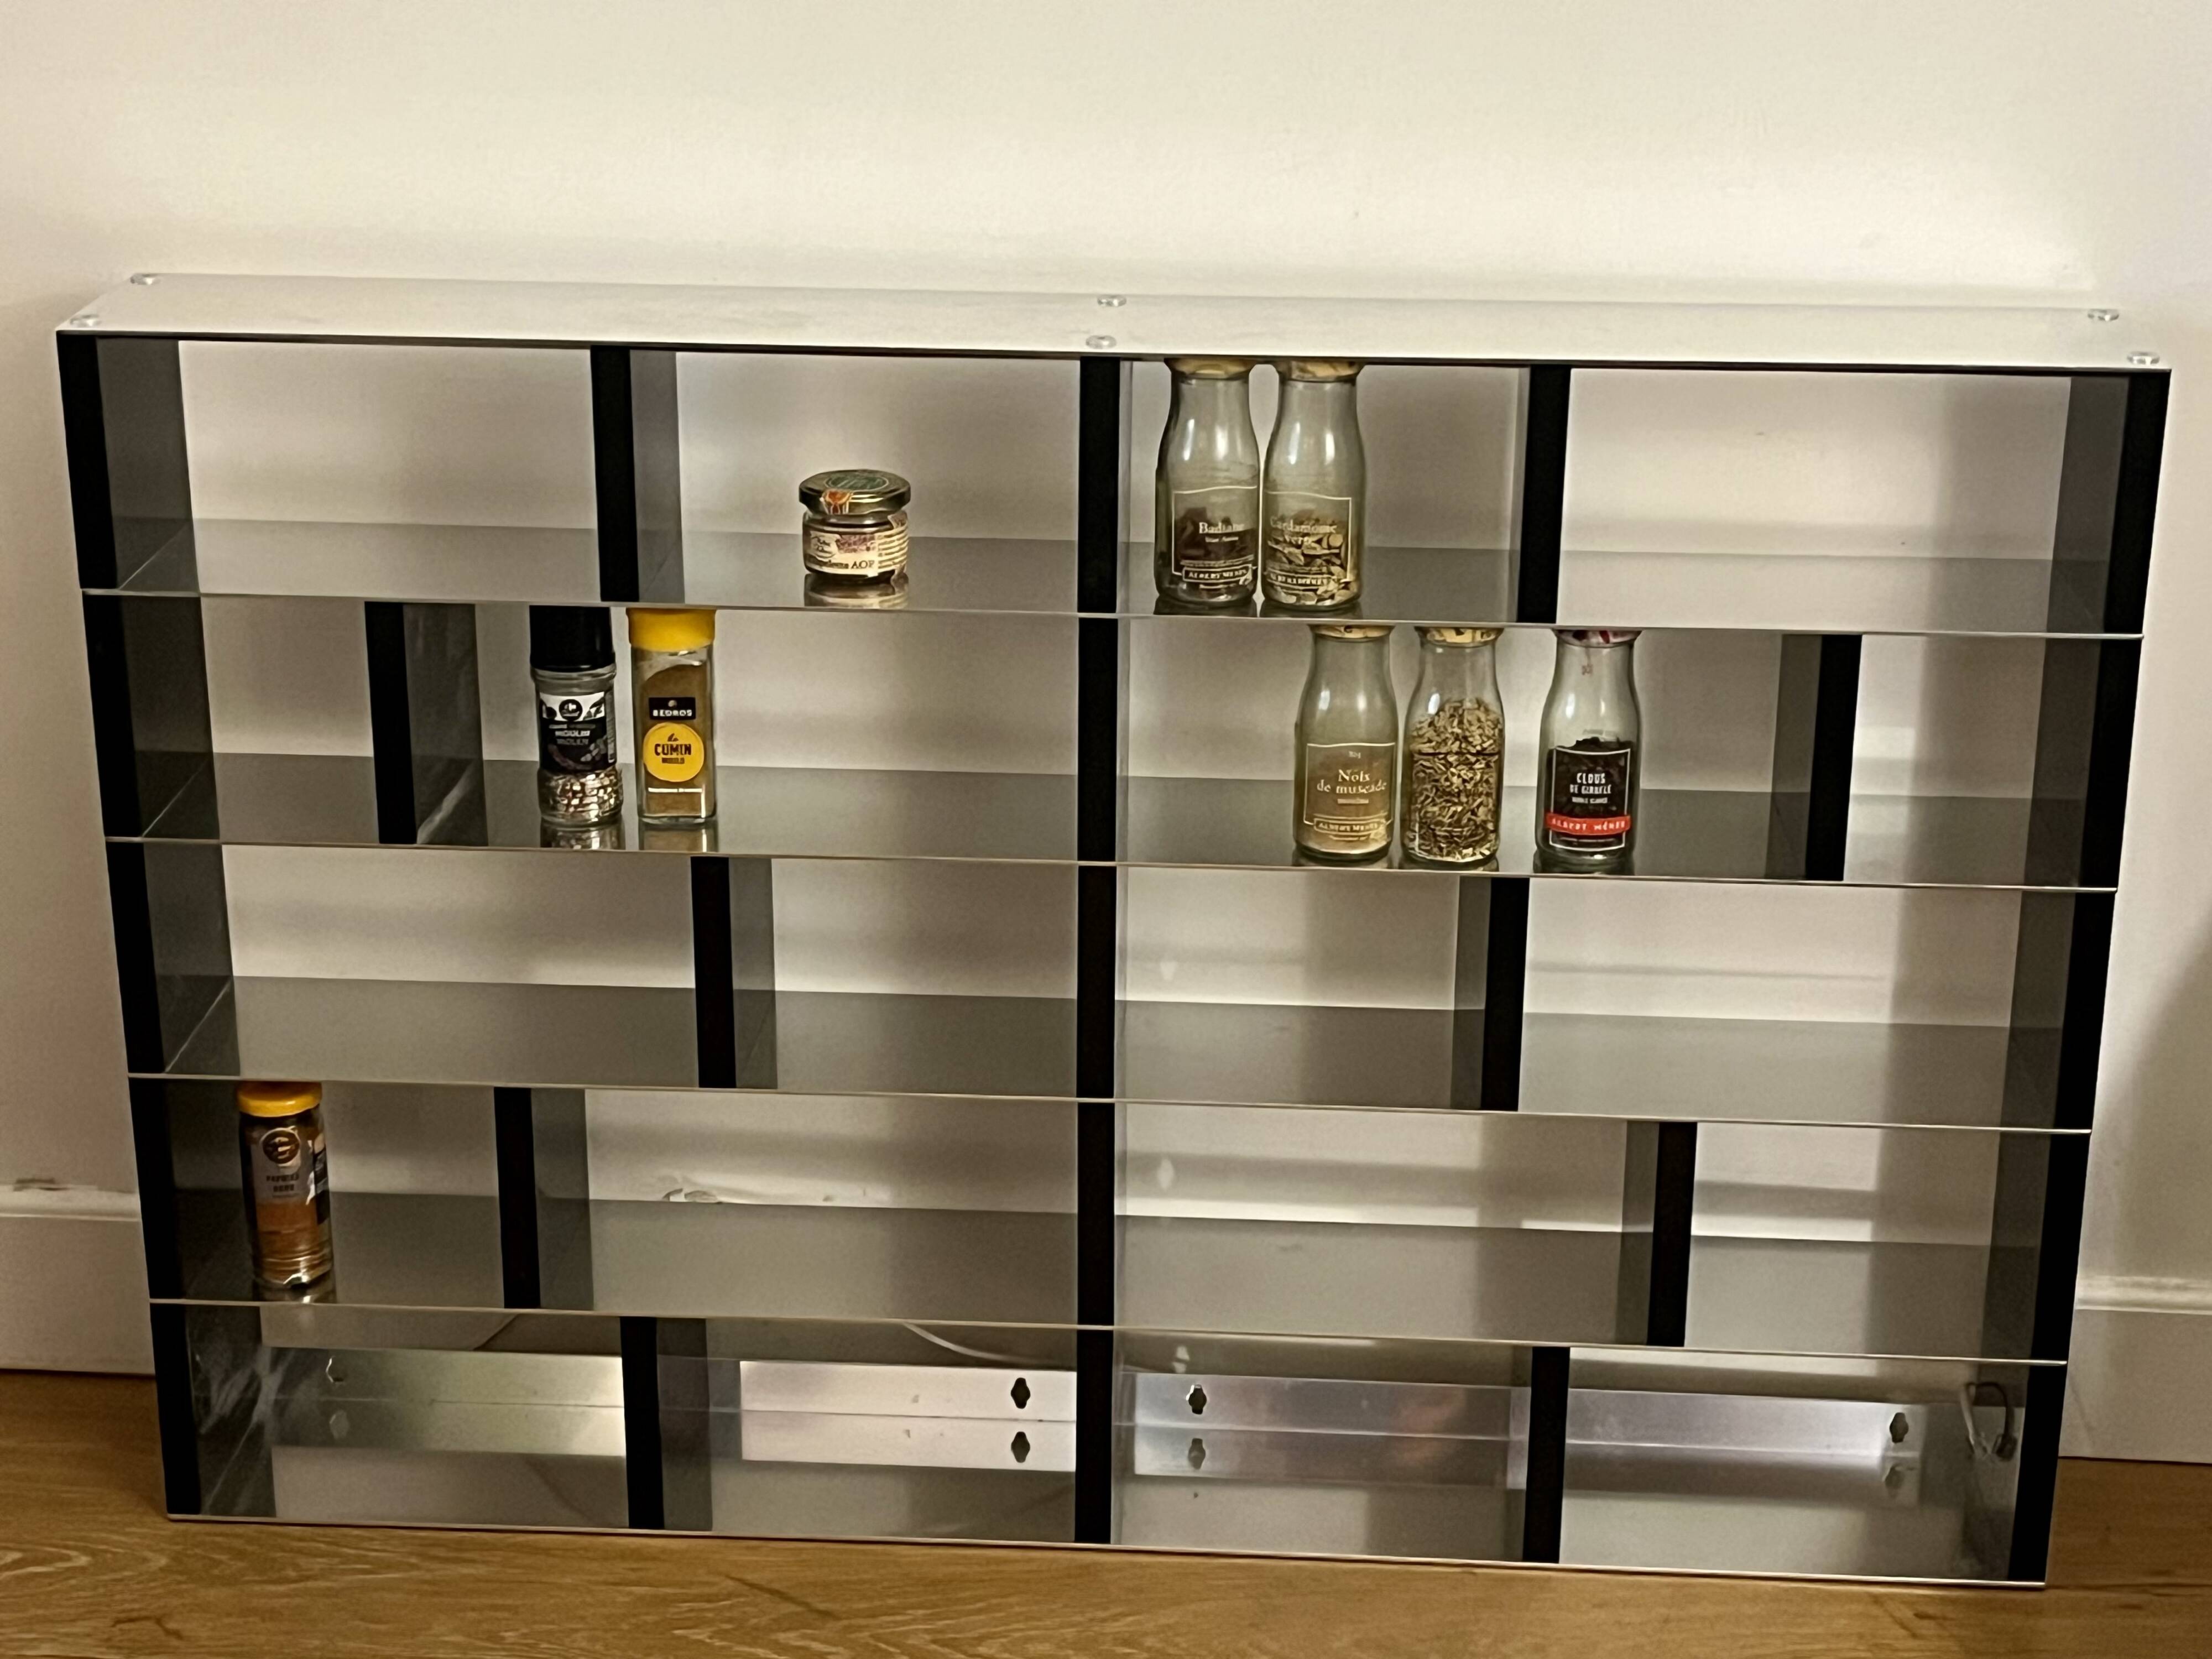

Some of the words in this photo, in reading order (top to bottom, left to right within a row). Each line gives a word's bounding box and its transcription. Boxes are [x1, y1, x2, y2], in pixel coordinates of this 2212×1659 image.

[654, 743, 692, 756] CUMIN
[1577, 773, 1606, 784] CLOUS
[1317, 779, 1331, 792] de
[1336, 779, 1387, 794] muscade
